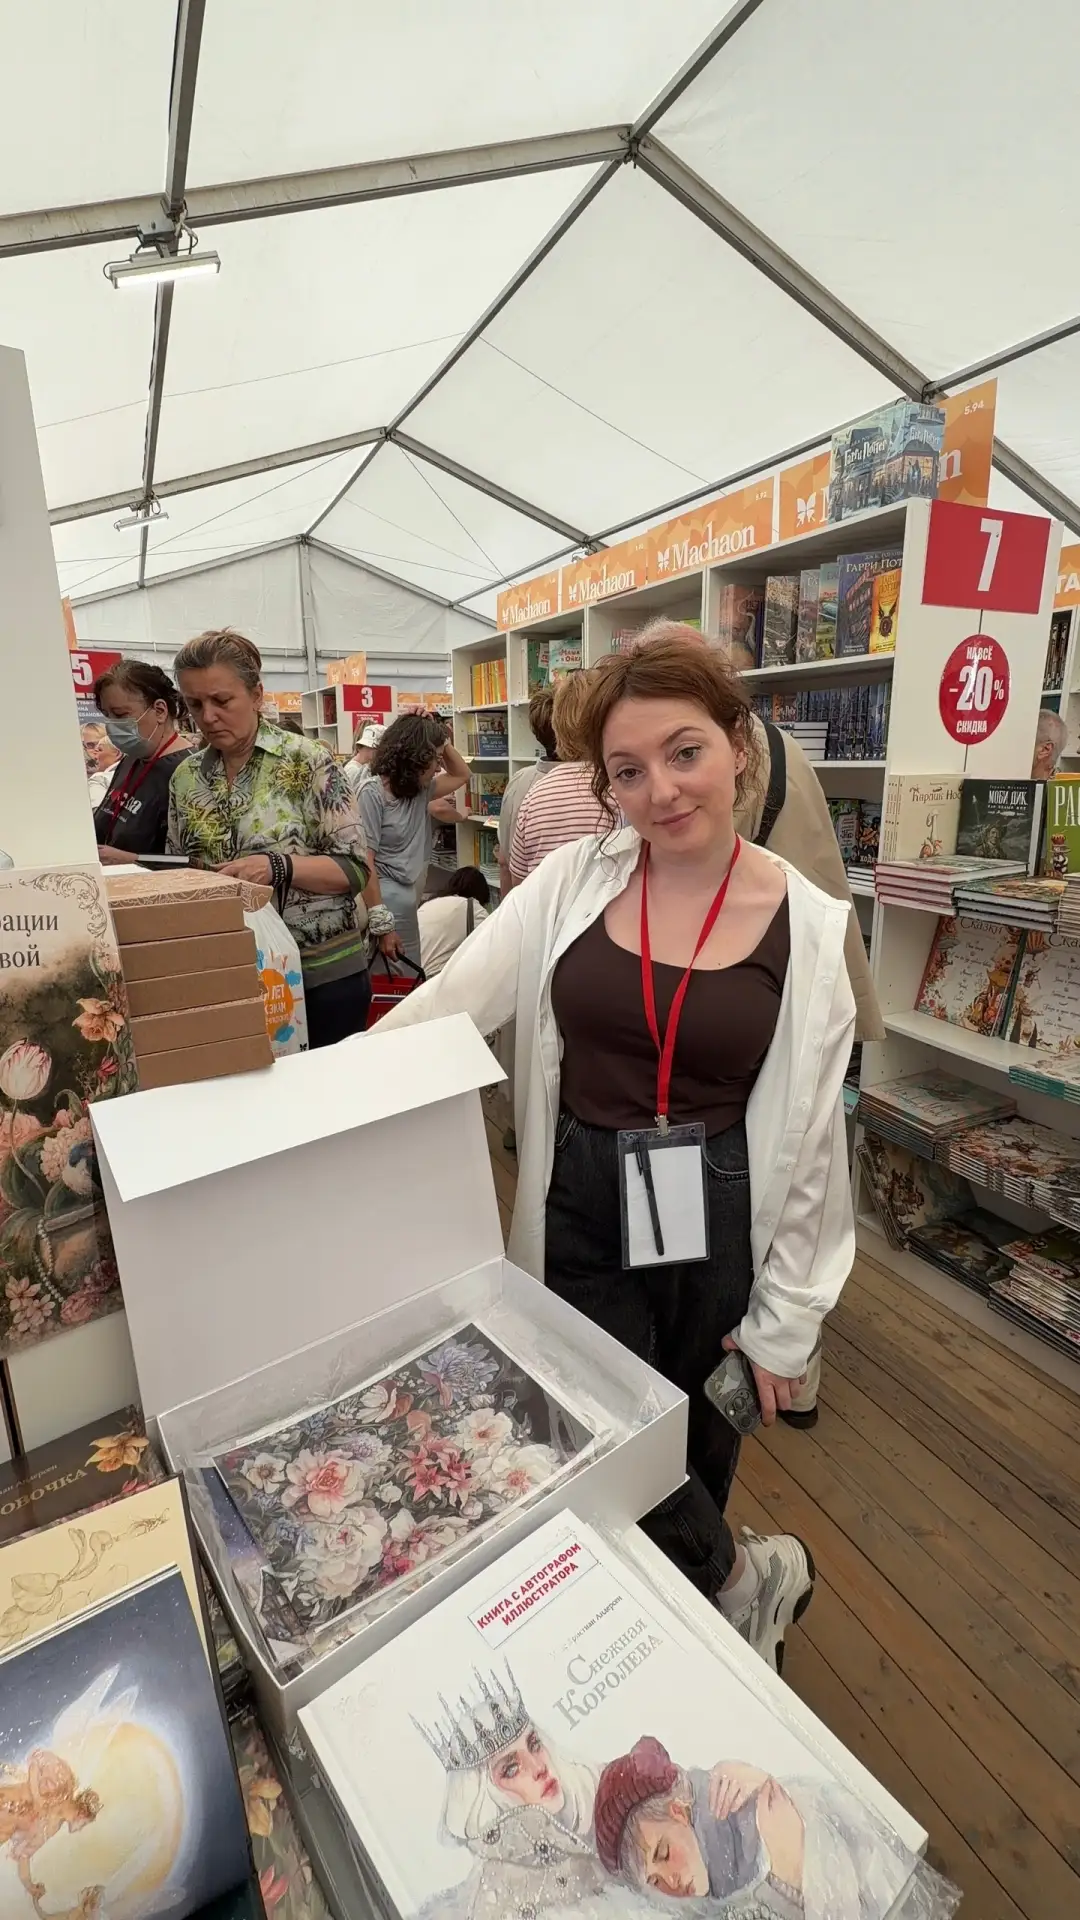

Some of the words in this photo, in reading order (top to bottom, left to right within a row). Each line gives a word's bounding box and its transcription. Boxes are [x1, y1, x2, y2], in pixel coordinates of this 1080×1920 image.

[964, 399, 985, 416] 5.94
[671, 520, 756, 572] Machaon
[977, 517, 1004, 592] 7
[846, 561, 878, 573] ГАРРИ
[577, 565, 636, 603] Machaon
[508, 597, 551, 624] Machaon
[978, 645, 993, 661] ВСЁ
[71, 653, 94, 686] 5
[361, 686, 374, 708] 3
[956, 719, 988, 735] СКИДКА
[988, 790, 1009, 805] МОБИ
[1010, 791, 1028, 806] ДИК
[1053, 785, 1080, 827] РА
[0, 914, 60, 937] ации
[1048, 932, 1080, 949] Ска
[477, 1598, 513, 1630] КНИГА
[511, 1591, 522, 1602] С
[520, 1543, 582, 1594] АВТОГРАФОМ
[501, 1562, 579, 1626] ИЛЛЮСТРАТОРА
[566, 1618, 648, 1686] Снежная
